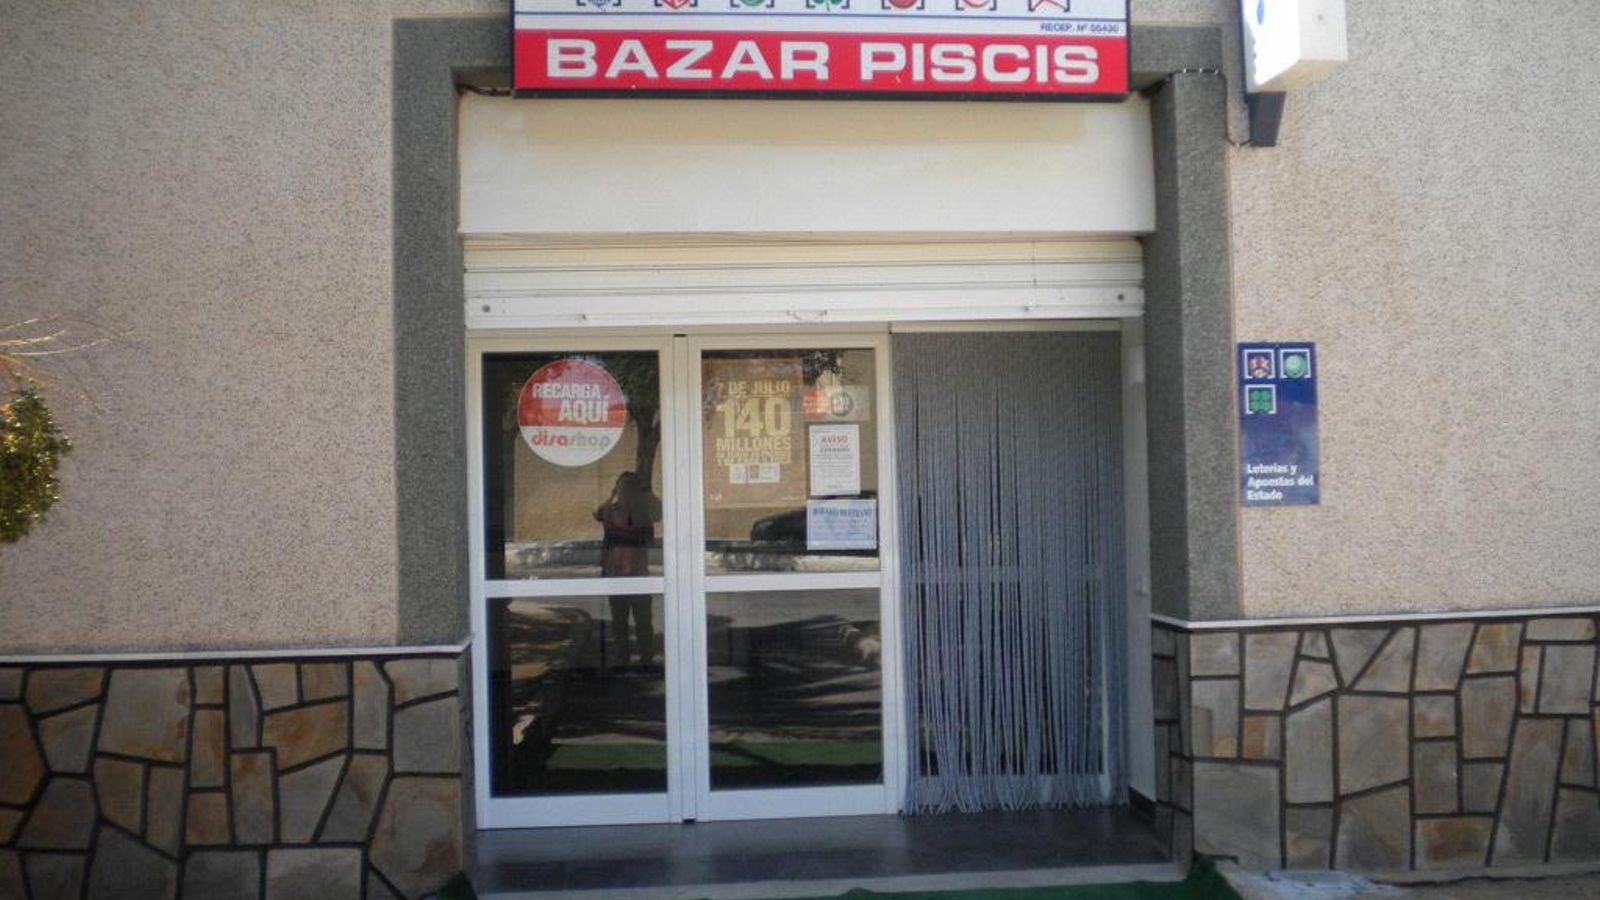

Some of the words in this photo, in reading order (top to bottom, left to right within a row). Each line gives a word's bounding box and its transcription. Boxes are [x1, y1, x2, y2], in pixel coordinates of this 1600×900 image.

[545, 38, 831, 81] BAZAR
[859, 42, 1100, 84] PISCIS
[532, 382, 601, 399] RECARGA
[728, 381, 748, 394] DE
[750, 381, 791, 395] JULIO
[558, 395, 610, 425] AQUÍ
[716, 398, 792, 438] 140
[716, 437, 792, 451] MILLONES
[1290, 464, 1298, 476] y
[1247, 476, 1295, 489] Apuestas
[1297, 475, 1314, 486] del
[1247, 489, 1284, 501] Estado
